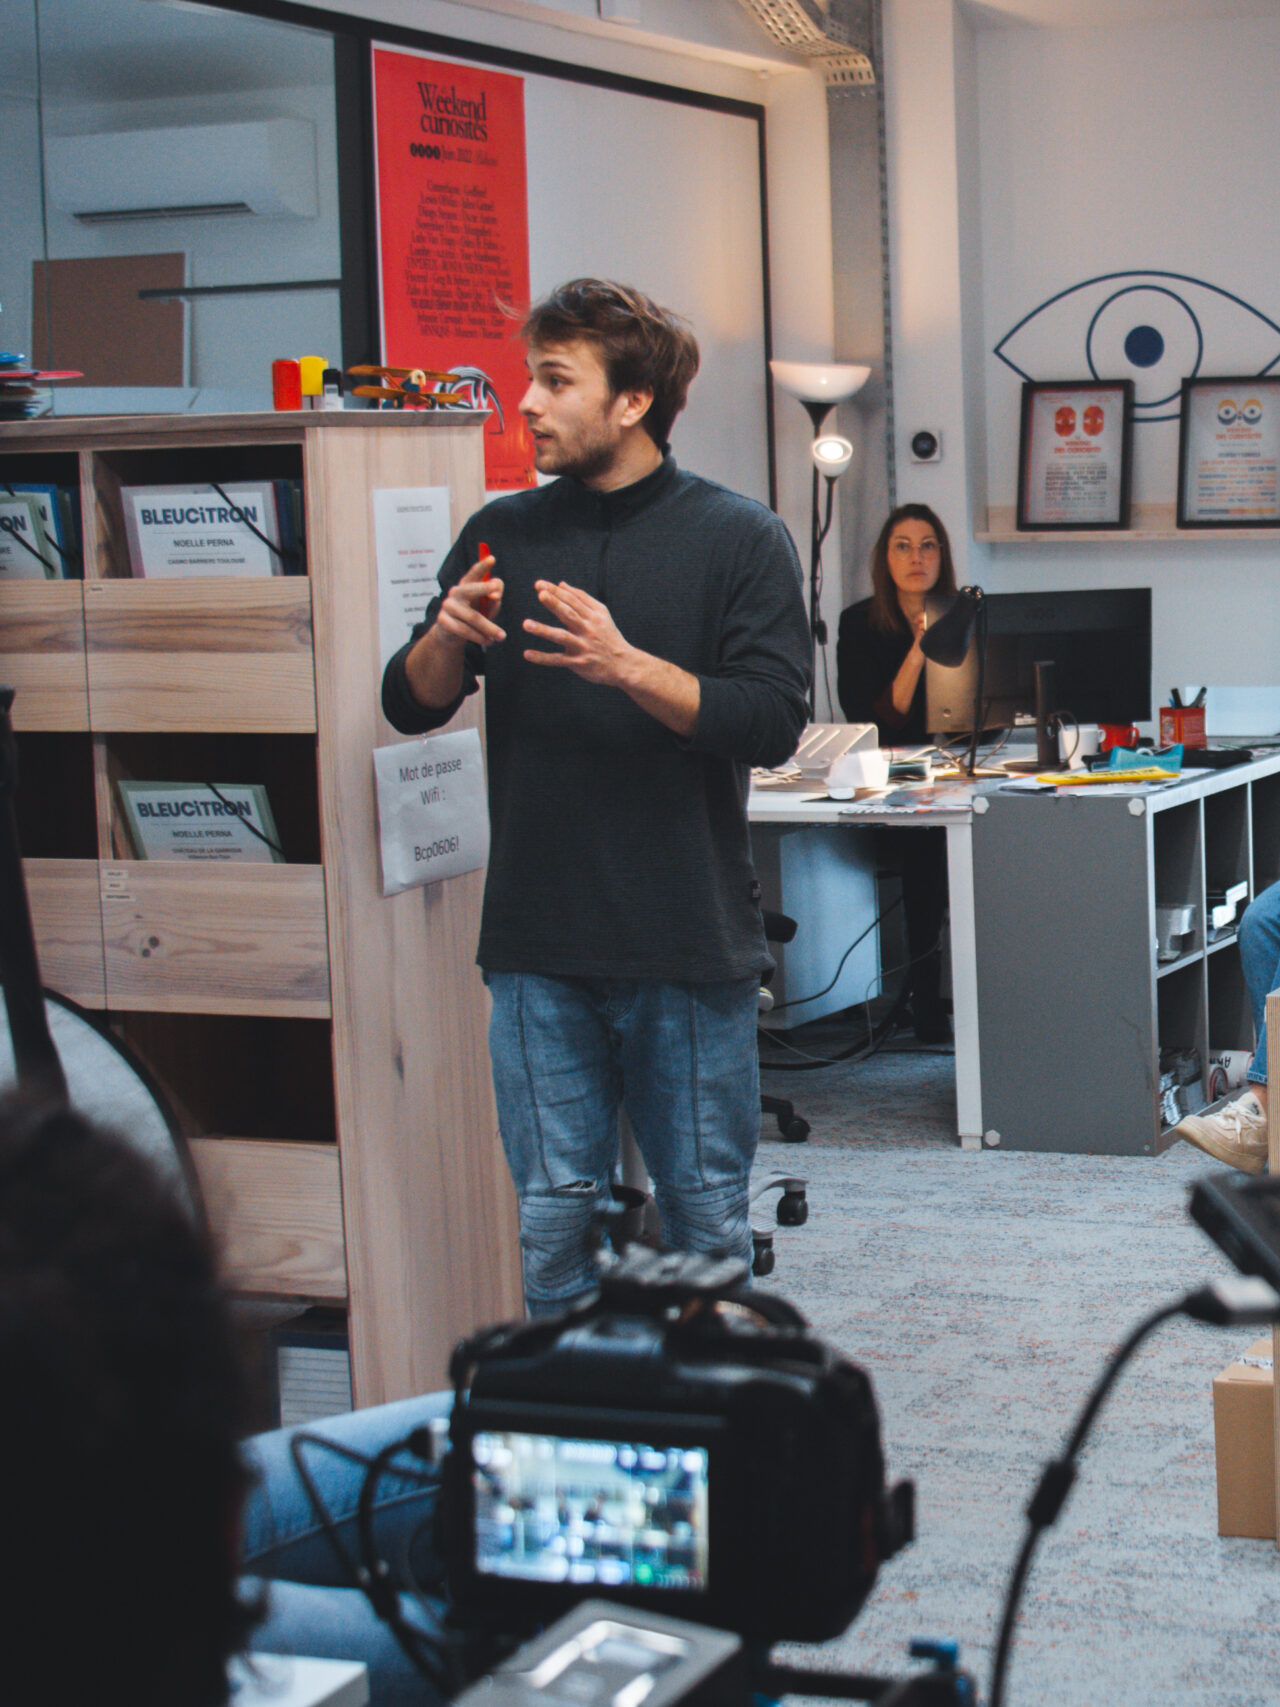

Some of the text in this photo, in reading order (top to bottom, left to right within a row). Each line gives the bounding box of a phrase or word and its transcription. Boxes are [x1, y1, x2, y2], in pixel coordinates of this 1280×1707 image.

[416, 81, 487, 121] Weekend
[173, 538, 236, 548] NOELLE PERNA
[400, 757, 463, 783] Mot de passe
[420, 786, 441, 806] Wifi
[172, 829, 233, 839] NOELLE PERNA
